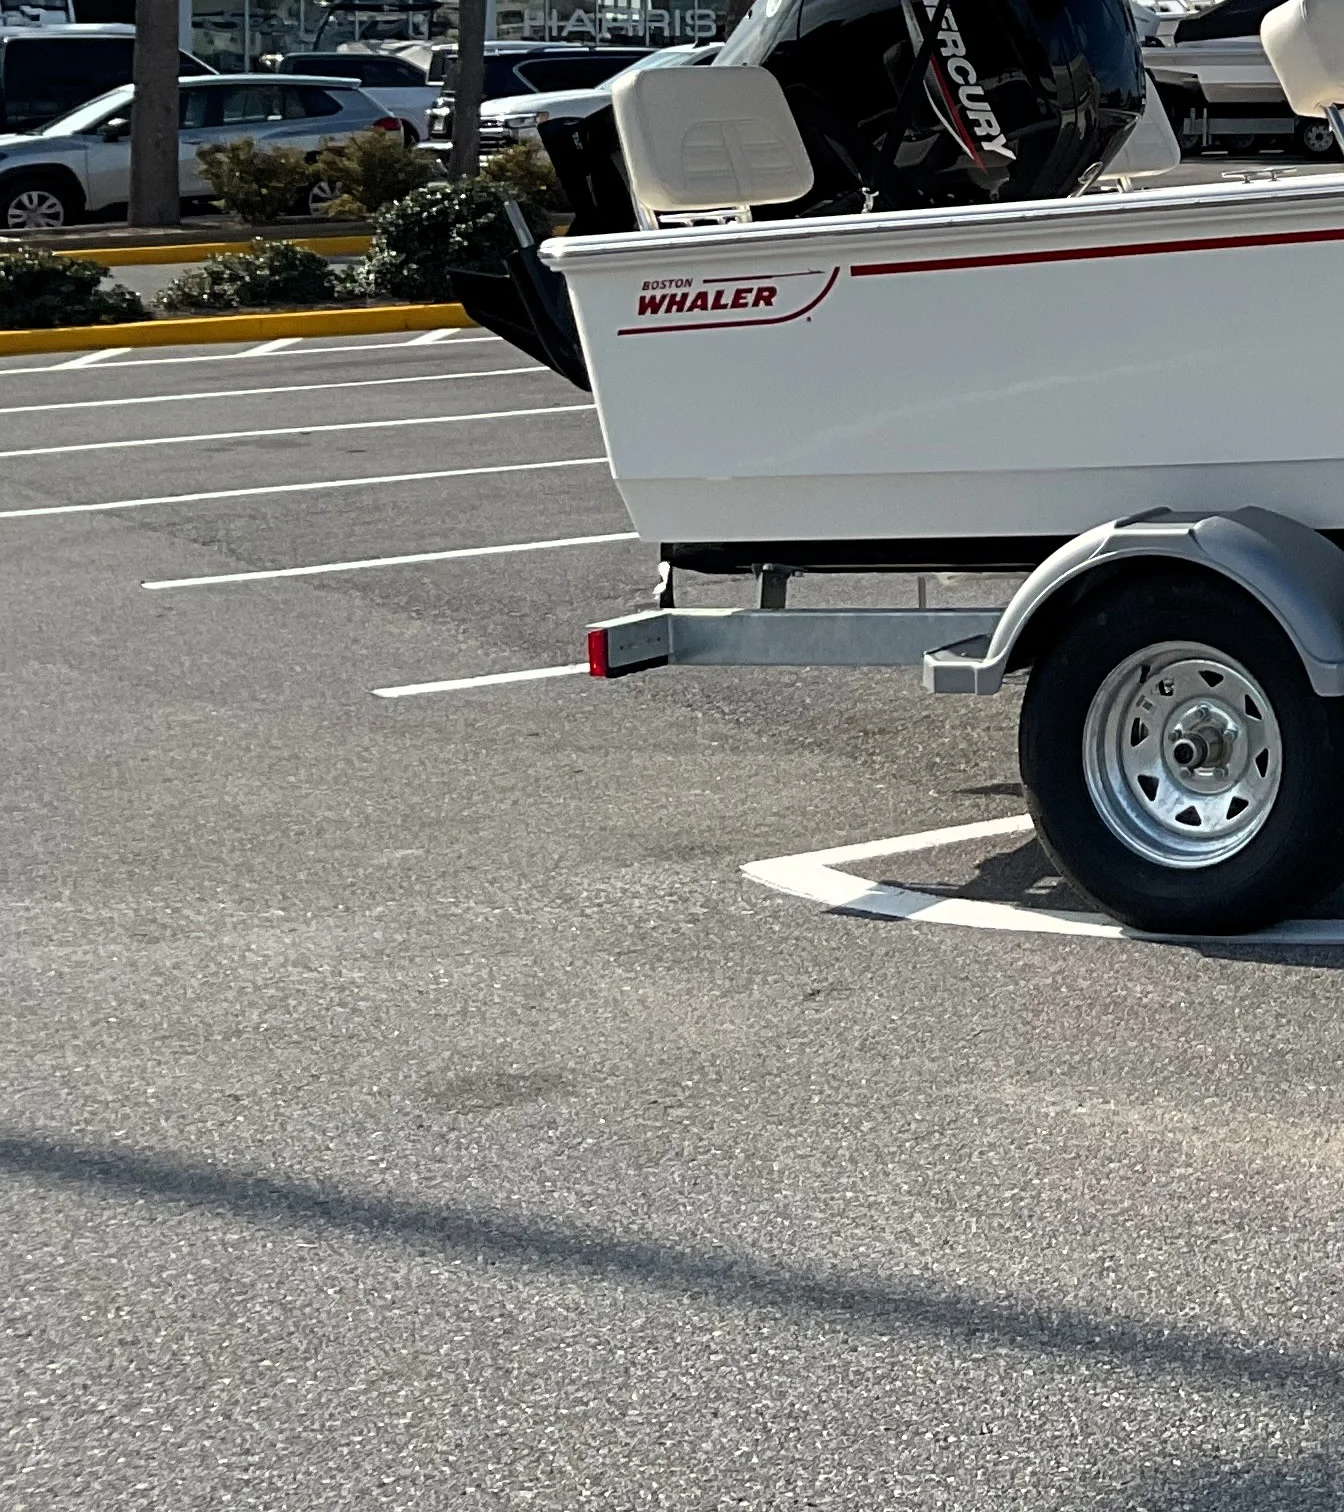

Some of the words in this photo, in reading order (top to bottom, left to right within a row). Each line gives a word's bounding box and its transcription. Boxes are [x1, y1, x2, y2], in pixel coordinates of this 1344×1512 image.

[523, 8, 717, 37] HARRIS
[641, 278, 693, 291] BOSTON
[637, 286, 778, 316] WHALER
